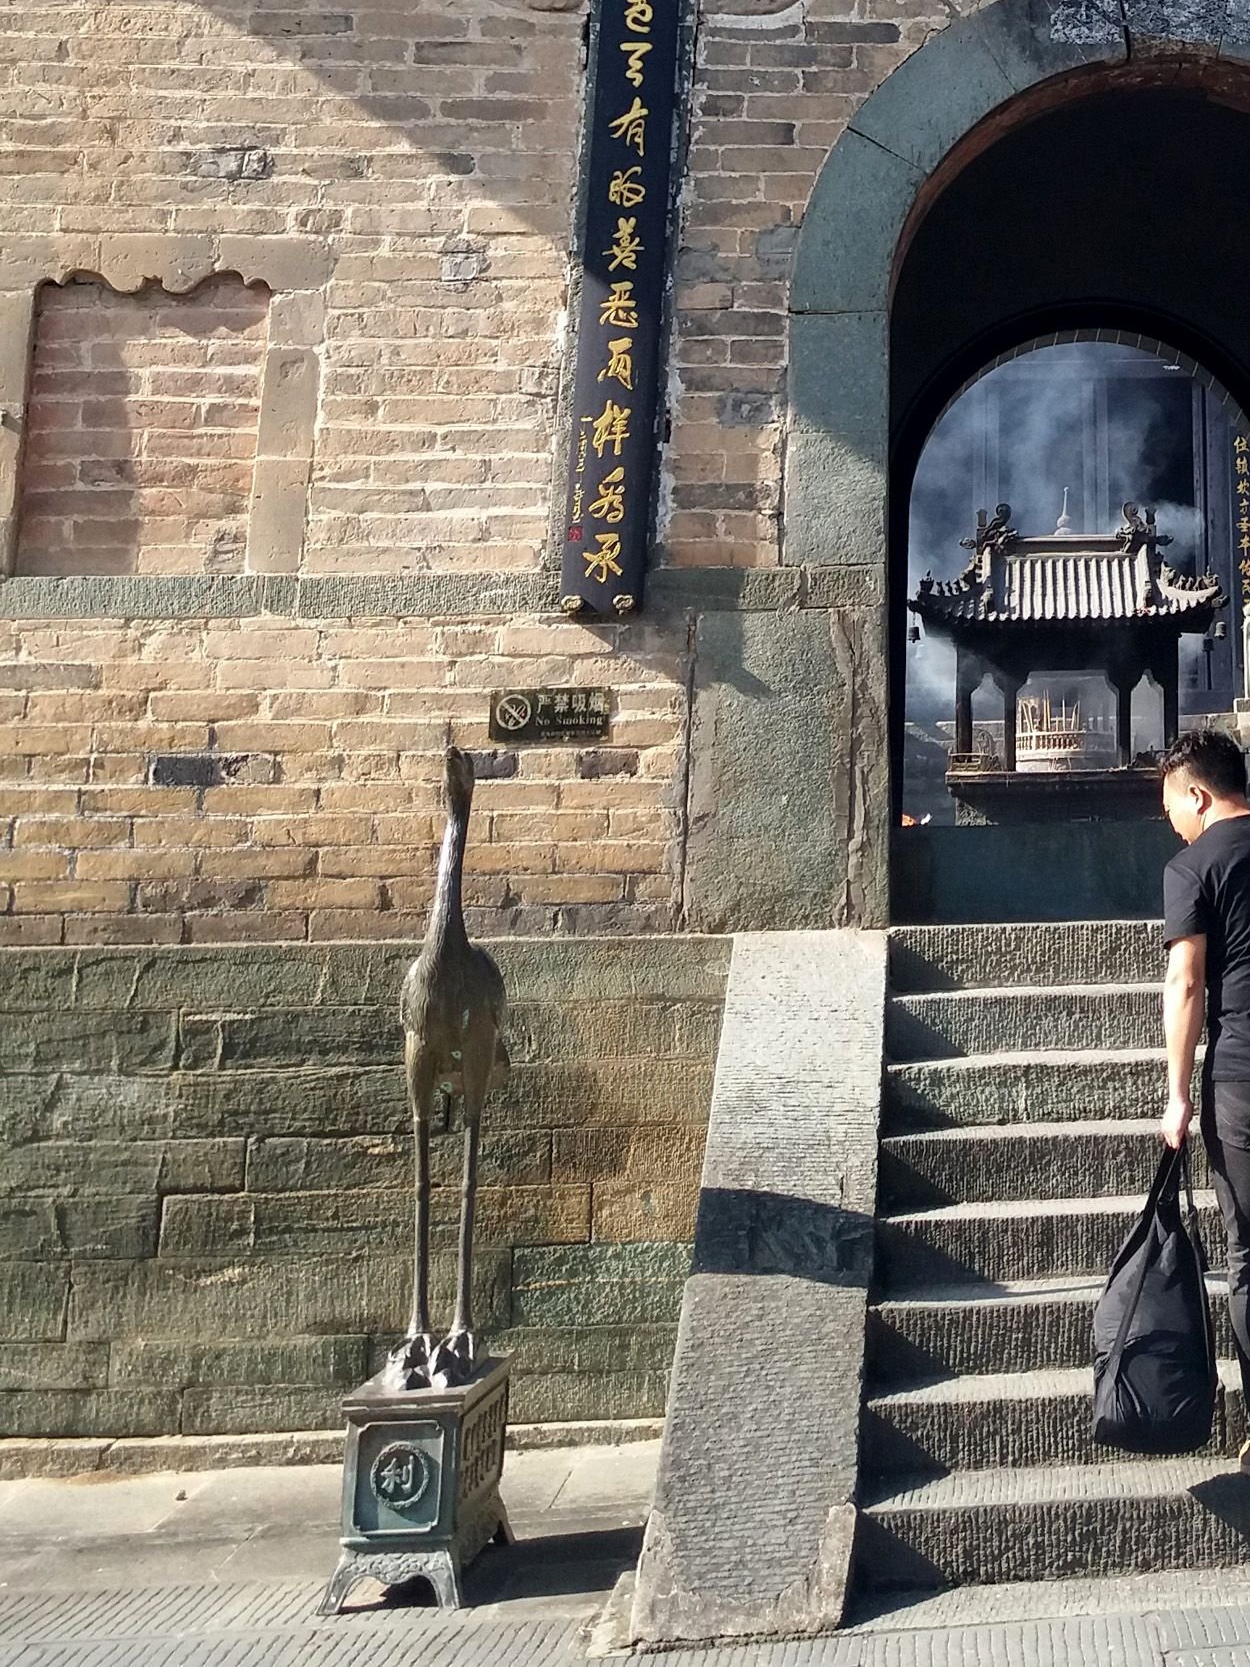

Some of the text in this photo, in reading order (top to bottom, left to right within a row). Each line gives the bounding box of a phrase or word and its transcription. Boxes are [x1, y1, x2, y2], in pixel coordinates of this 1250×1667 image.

[536, 692, 605, 715] 严禁吸烟
[535, 715, 603, 726] No Smoking
[380, 1454, 416, 1495] 利
